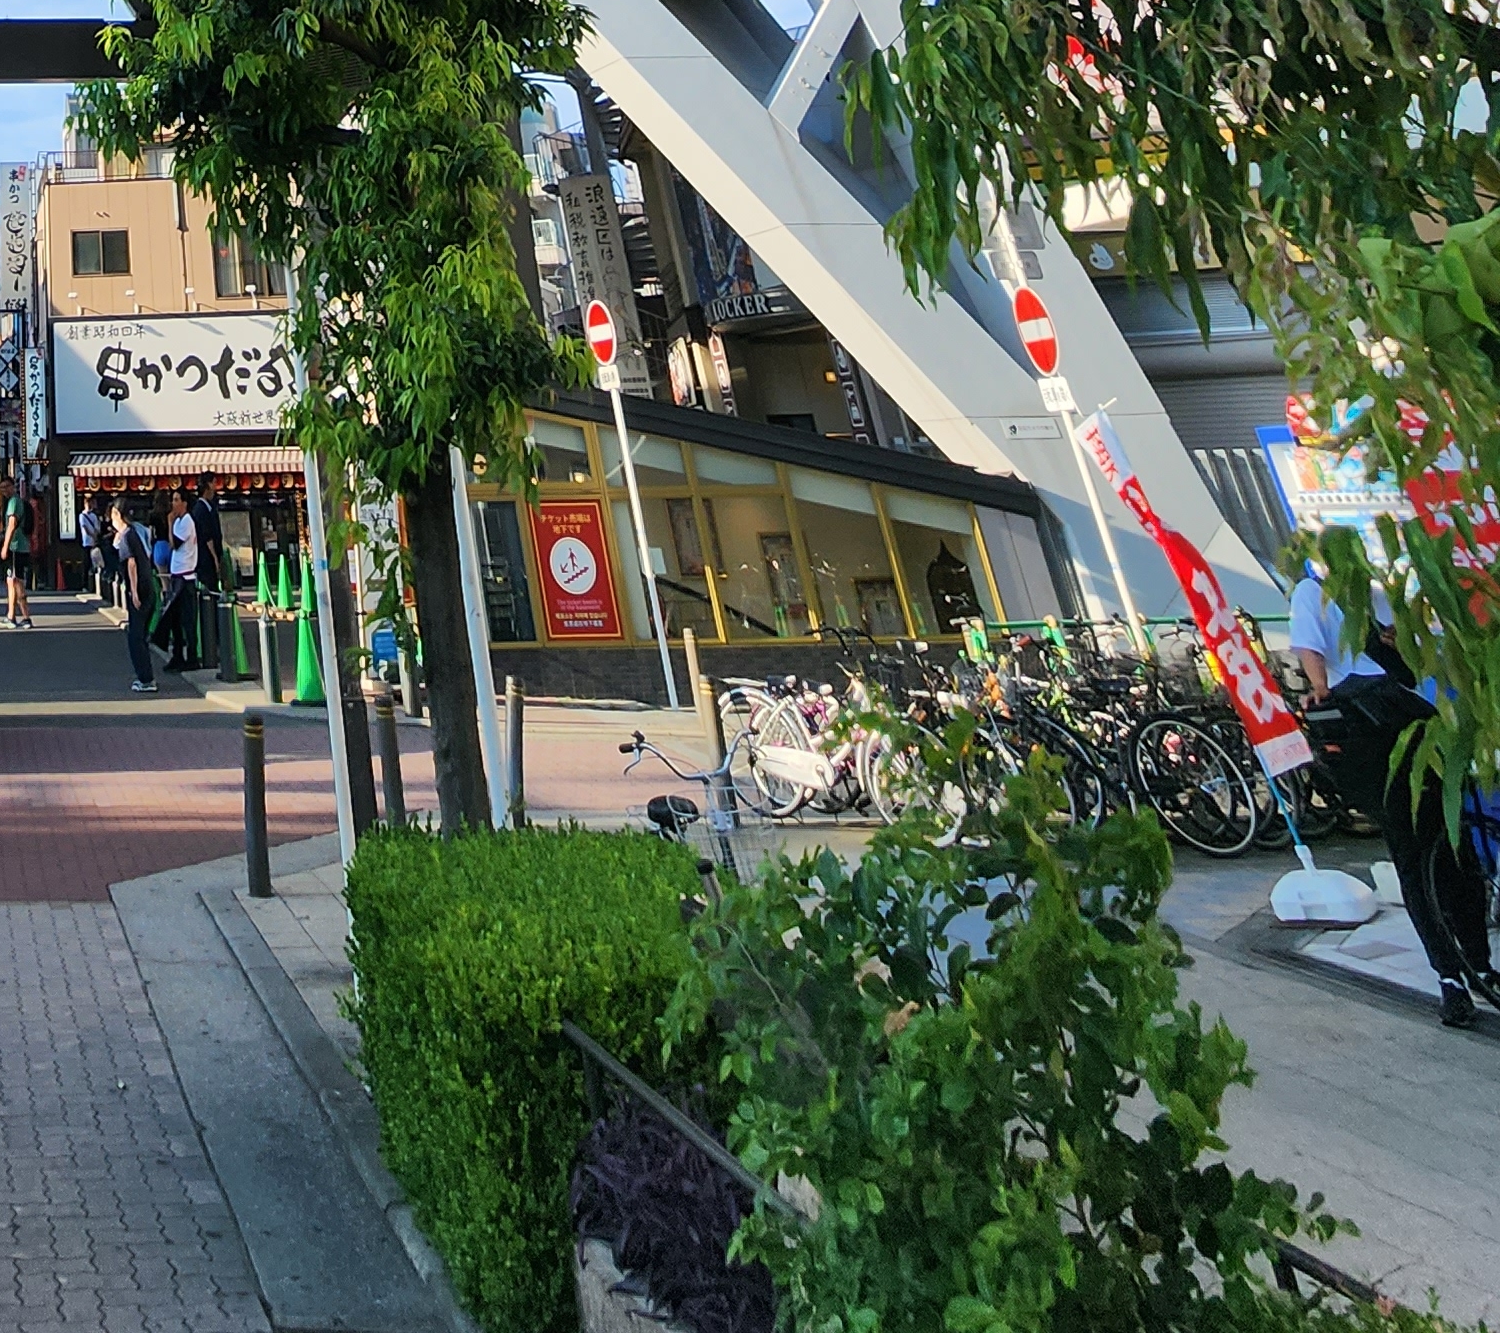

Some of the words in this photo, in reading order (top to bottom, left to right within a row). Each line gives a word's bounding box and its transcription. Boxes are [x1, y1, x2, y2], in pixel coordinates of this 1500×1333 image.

[711, 293, 770, 321] LOCKER
[97, 341, 298, 413] 串かつだる
